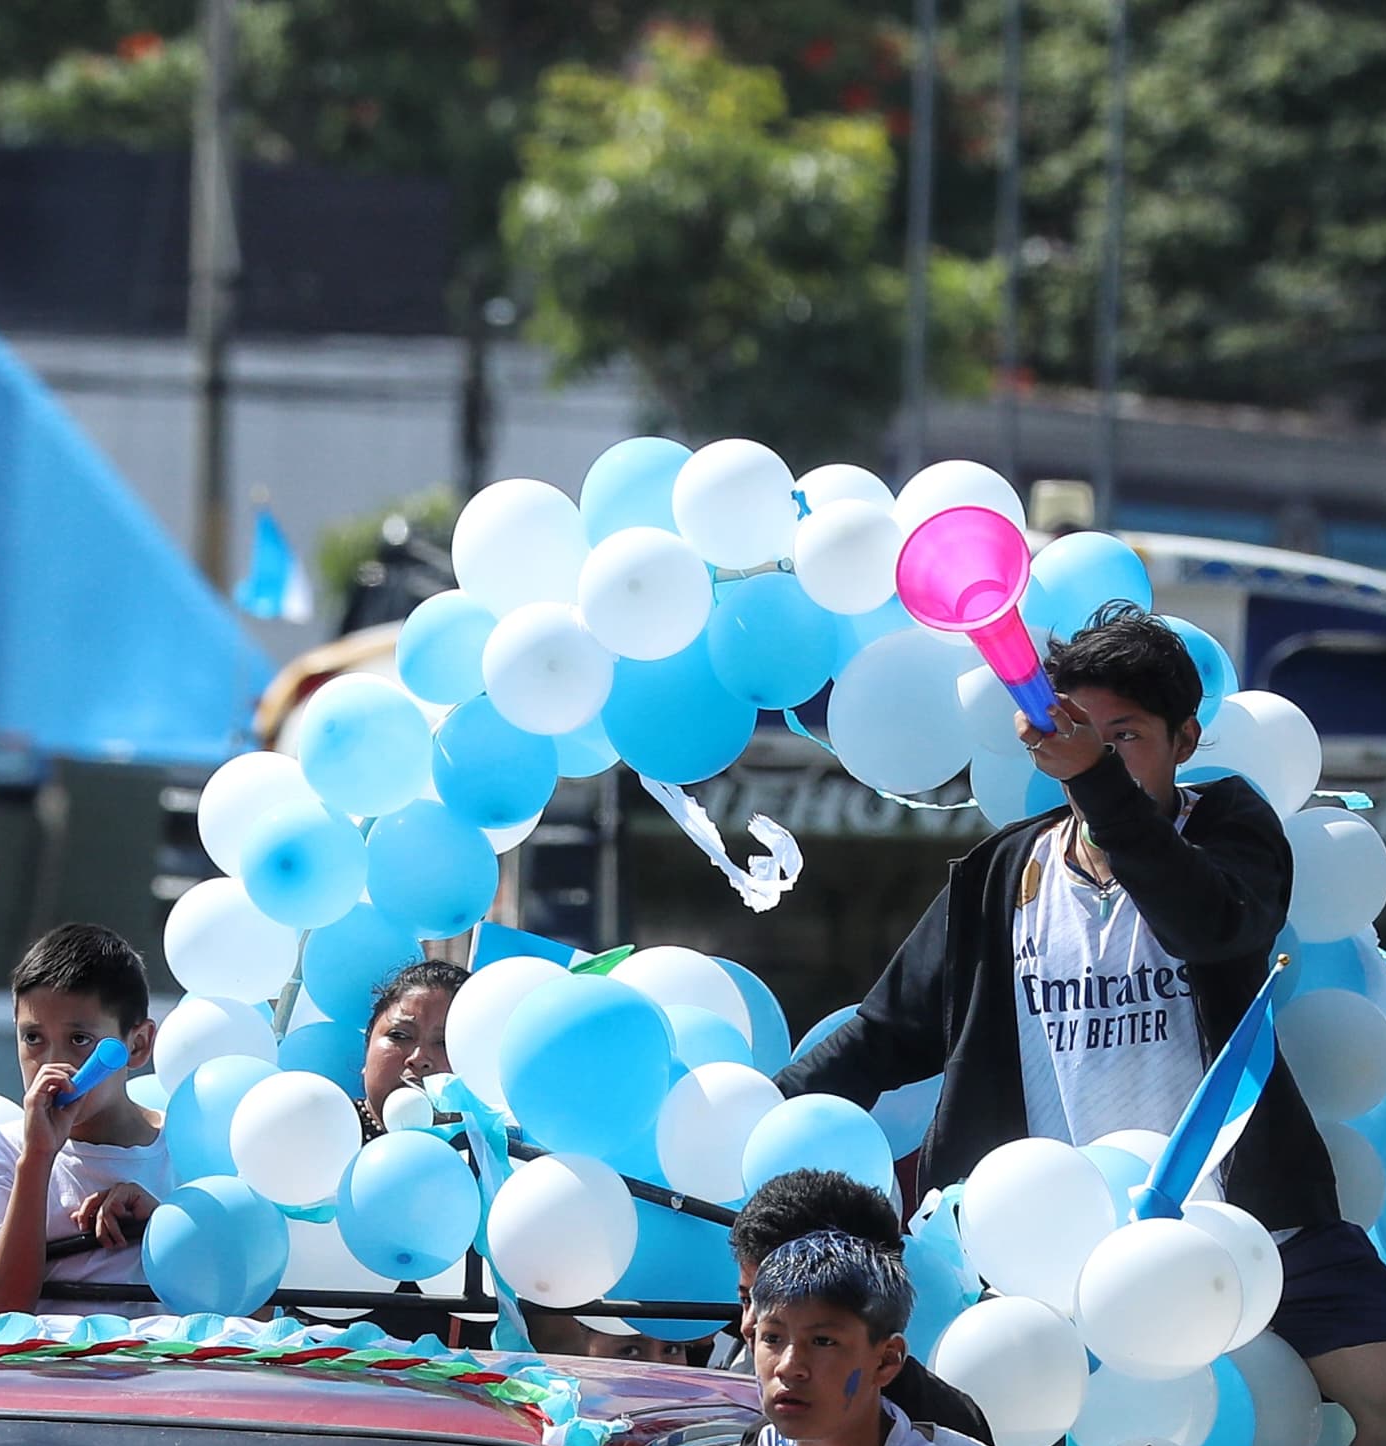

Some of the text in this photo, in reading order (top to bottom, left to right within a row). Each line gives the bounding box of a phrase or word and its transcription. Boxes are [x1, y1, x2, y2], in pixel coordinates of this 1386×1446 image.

[1022, 962, 1191, 1016] Emirates
[1047, 1009, 1168, 1052] FLY BETTER
